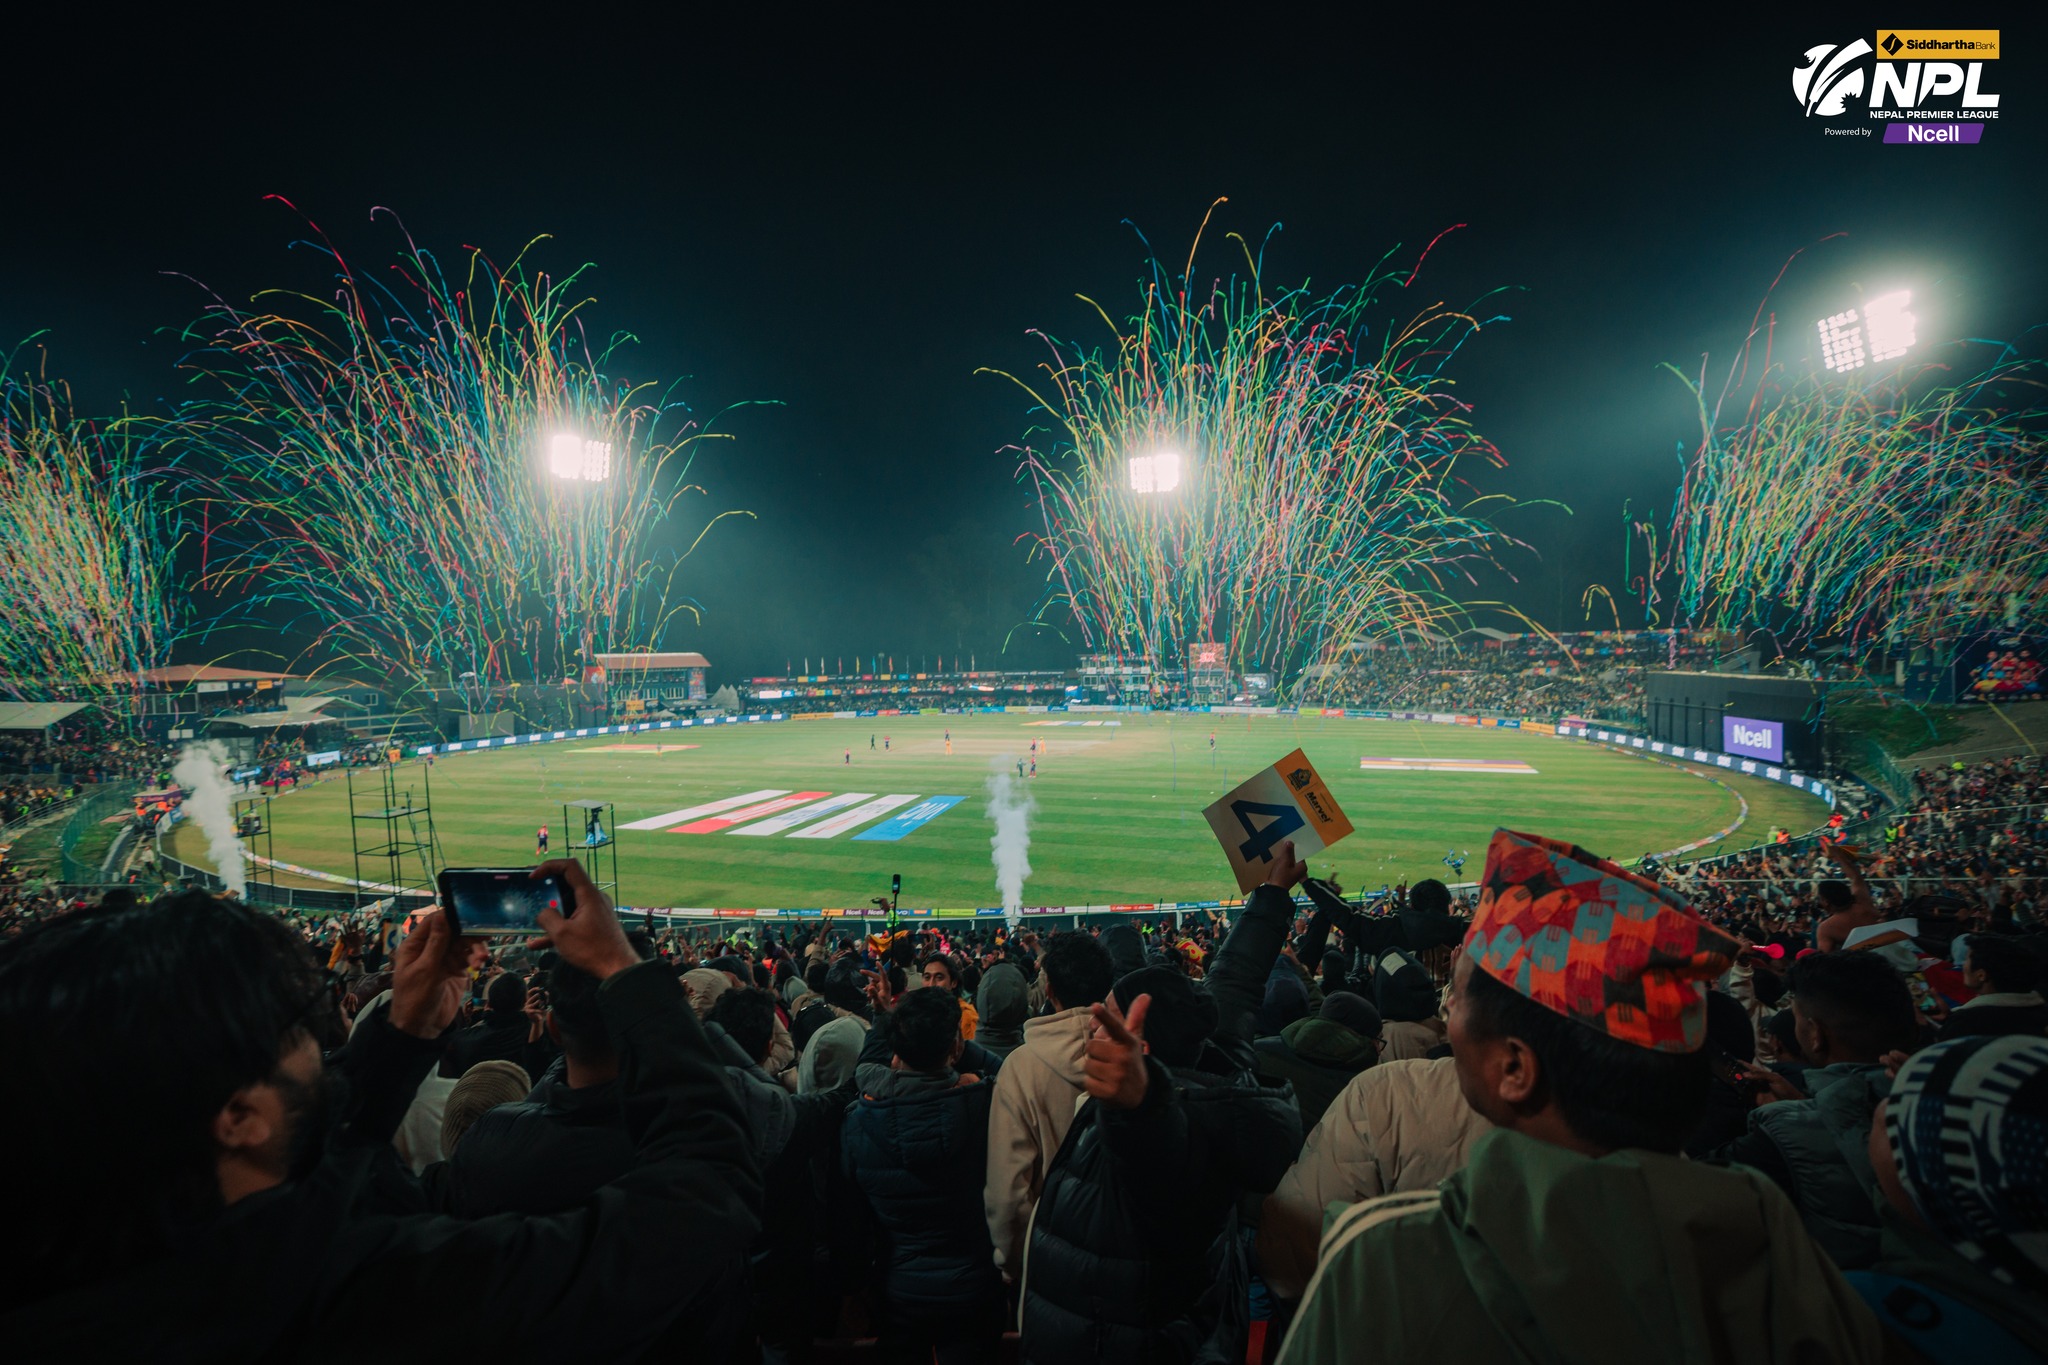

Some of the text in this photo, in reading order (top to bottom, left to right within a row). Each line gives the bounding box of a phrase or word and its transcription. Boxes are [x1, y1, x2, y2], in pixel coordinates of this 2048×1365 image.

[1733, 724, 1772, 750] Ncell
[1305, 791, 1332, 823] Marvel
[1230, 799, 1306, 865] 4
